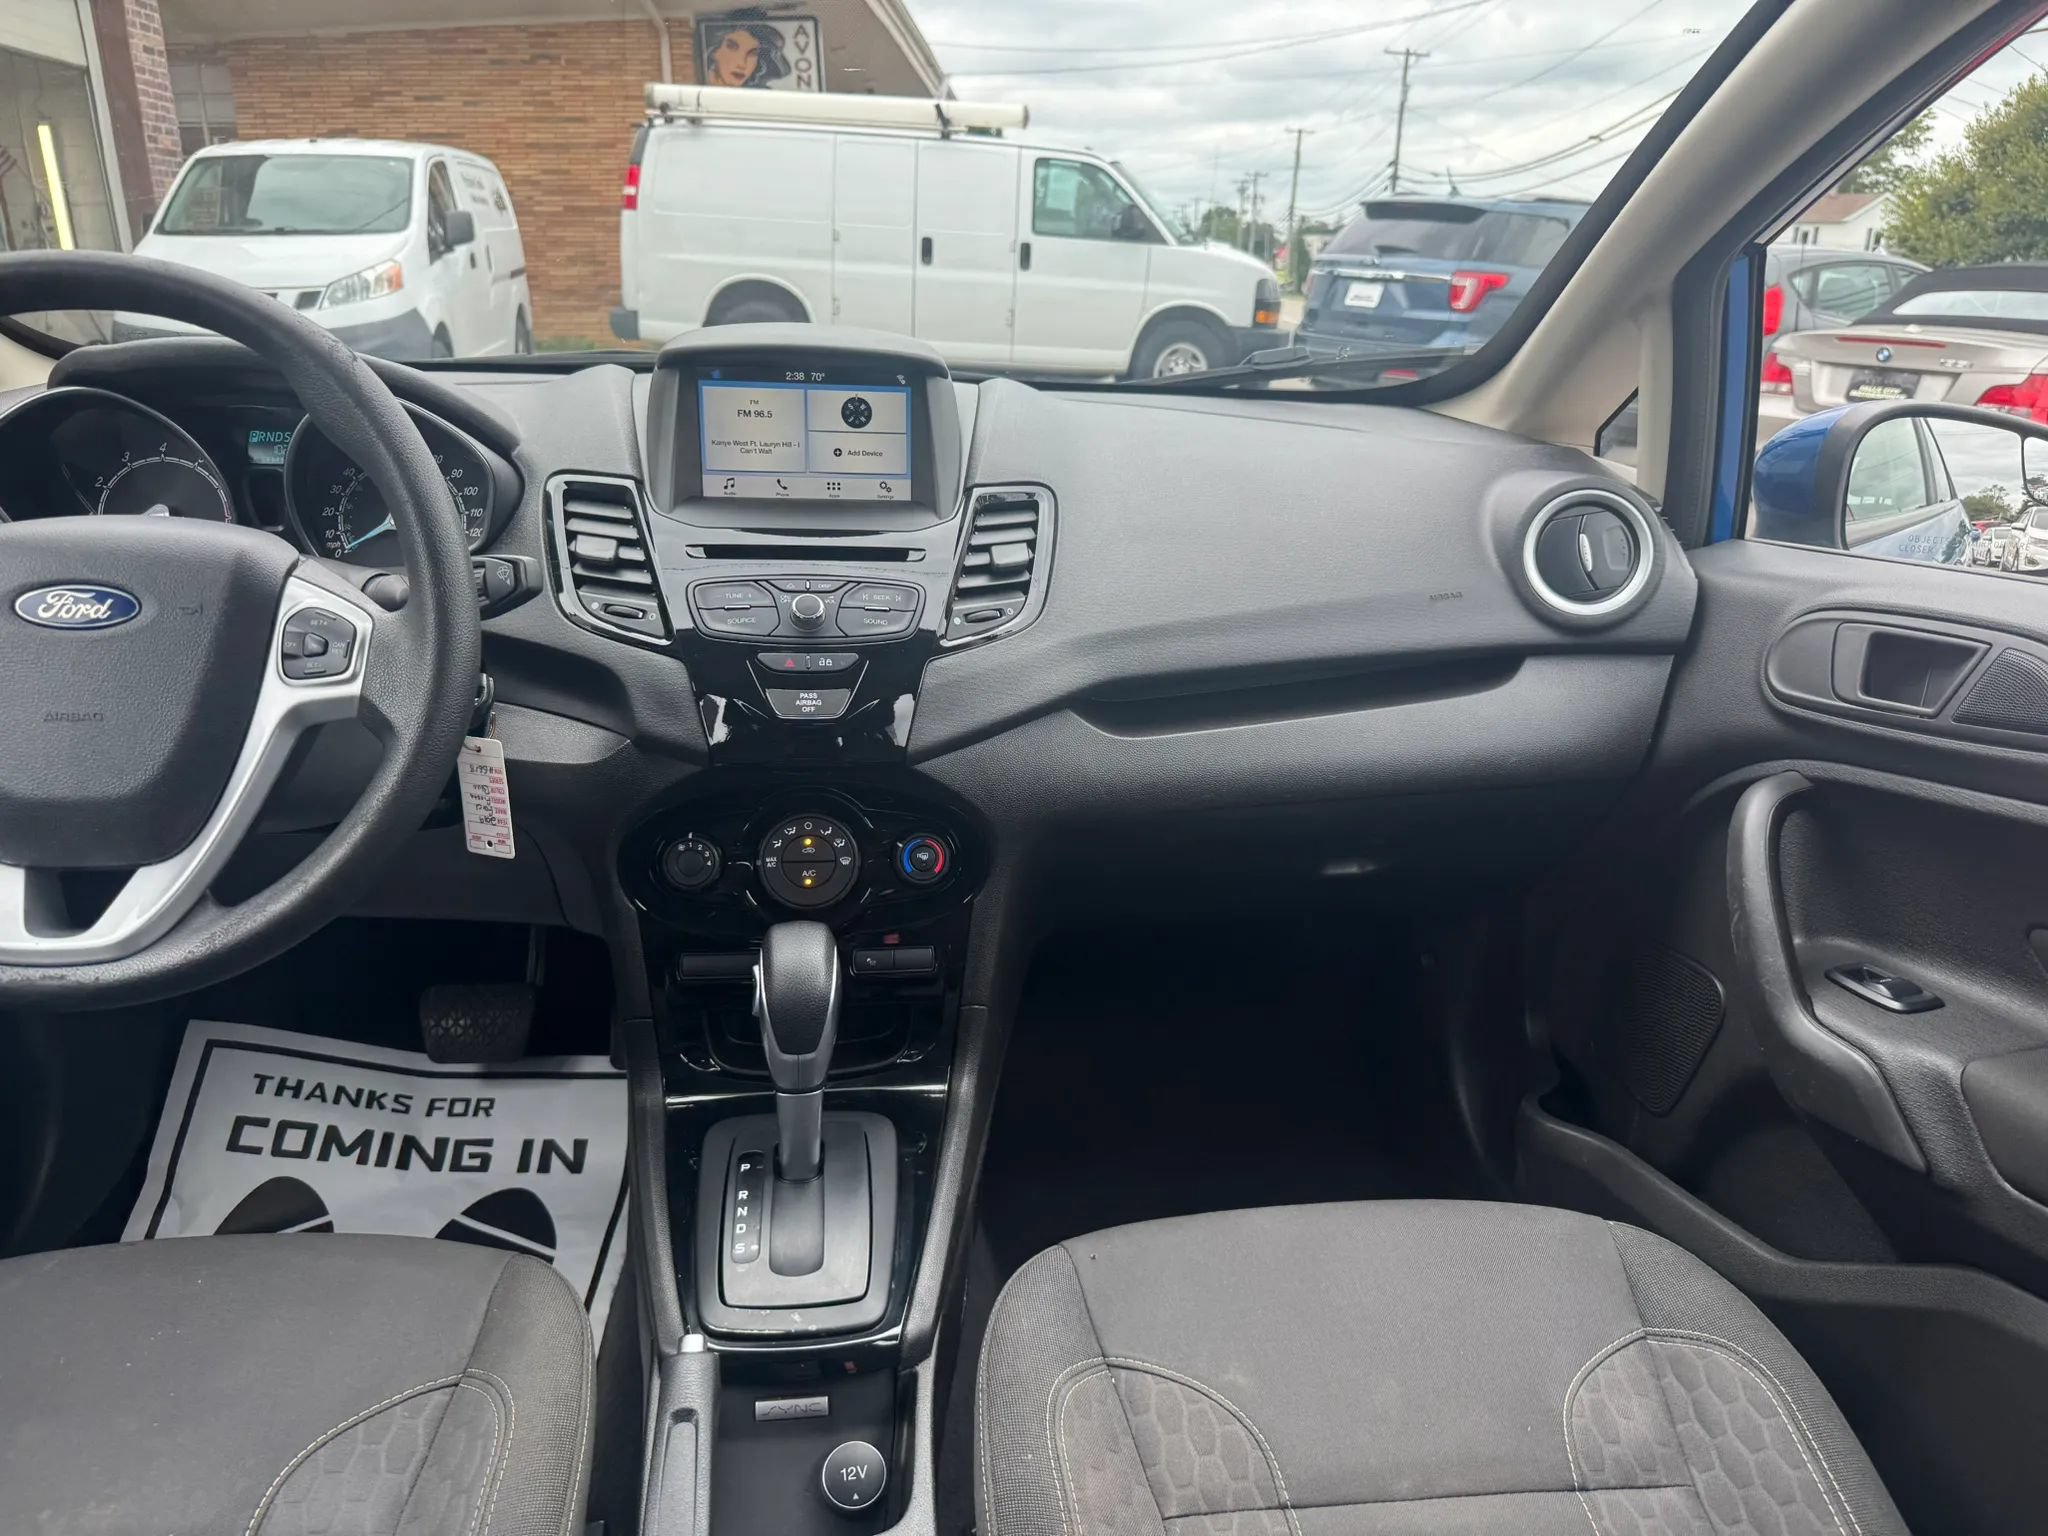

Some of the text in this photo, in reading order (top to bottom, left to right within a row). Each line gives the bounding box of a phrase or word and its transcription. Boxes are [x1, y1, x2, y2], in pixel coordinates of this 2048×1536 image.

[794, 24, 812, 88] AVON
[785, 371, 805, 381] 2:38
[737, 409, 773, 419] FM 96.5
[160, 442, 167, 452] 4
[122, 452, 130, 462] 3
[343, 467, 355, 476] 40
[451, 469, 463, 478] 90
[95, 477, 104, 487] 2
[330, 485, 342, 494] 30
[463, 487, 478, 495] 100
[322, 507, 334, 516] 20
[470, 508, 483, 516] 110
[325, 530, 334, 538] 10
[335, 550, 341, 558] 0
[37, 590, 114, 620] Ford
[727, 617, 756, 625] SOURCE
[43, 711, 104, 722] AIRBAG
[802, 869, 816, 877] A/C
[253, 1073, 495, 1118] THANKS FOR
[225, 1114, 589, 1174] COMING IN
[740, 1163, 750, 1172] P
[738, 1190, 748, 1199] R
[736, 1206, 748, 1216] N
[735, 1223, 746, 1233] D
[734, 1243, 745, 1254] S
[761, 1402, 822, 1417] SYNC
[840, 1465, 868, 1481] 12V
